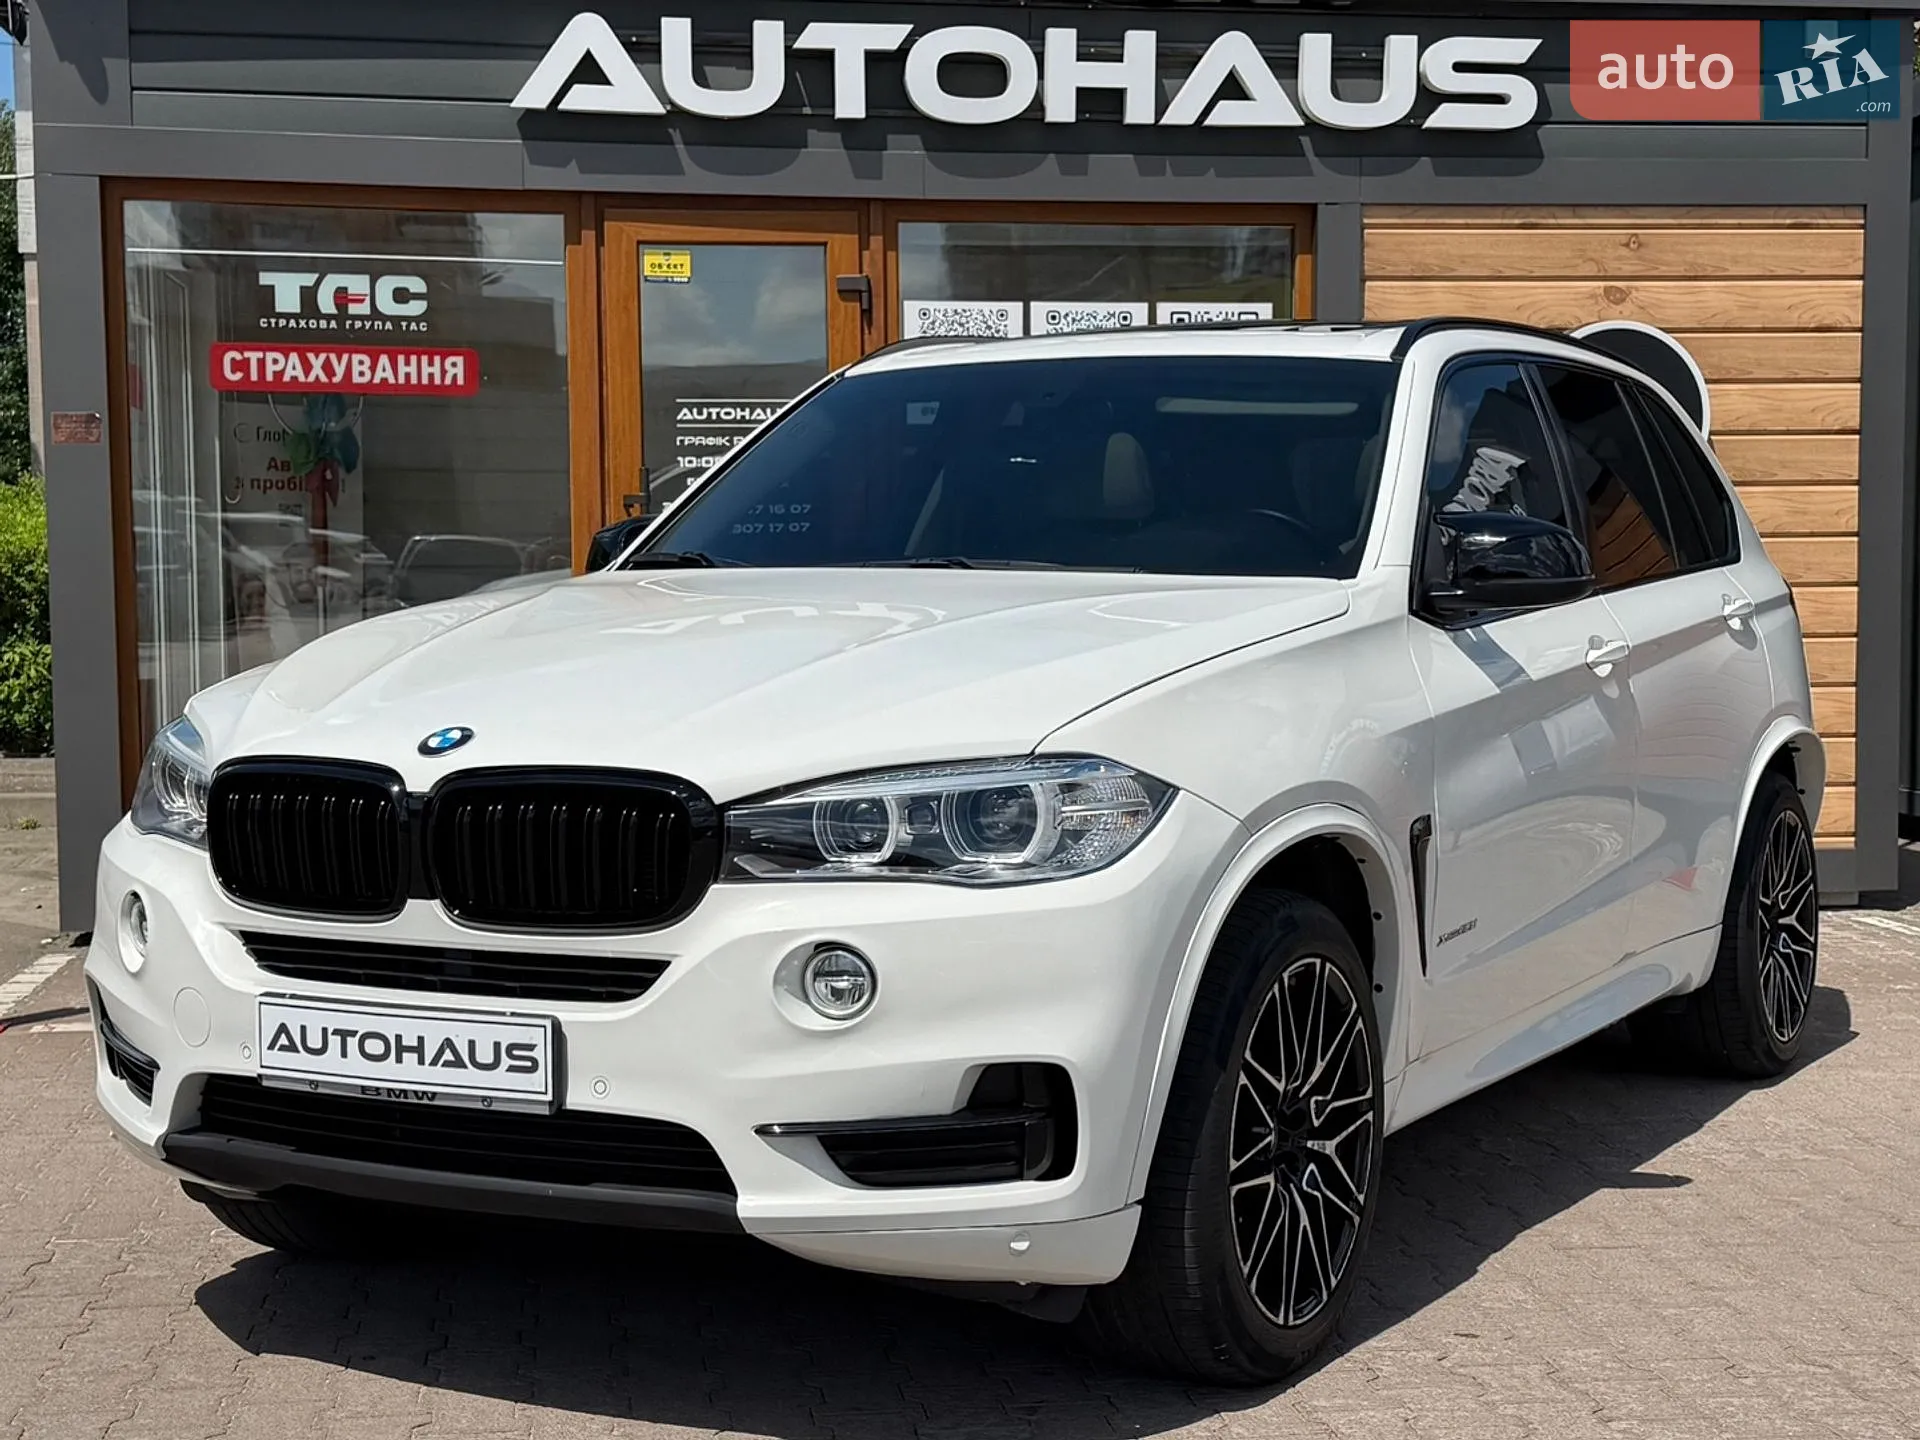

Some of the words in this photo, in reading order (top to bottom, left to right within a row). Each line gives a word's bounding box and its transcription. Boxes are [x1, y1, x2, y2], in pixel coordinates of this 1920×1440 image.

[510, 12, 1544, 131] AUTOHAUS
[259, 318, 338, 330] СТРАХОВА
[345, 320, 393, 331] ГРУПА
[401, 321, 428, 332] ТАС
[222, 350, 465, 386] СТРАХУВАННЯ
[790, 503, 811, 513] 07
[769, 523, 785, 533] 17
[788, 522, 811, 532] 07
[267, 1022, 539, 1074] AUTOHAUS
[360, 1085, 438, 1102] BMW
